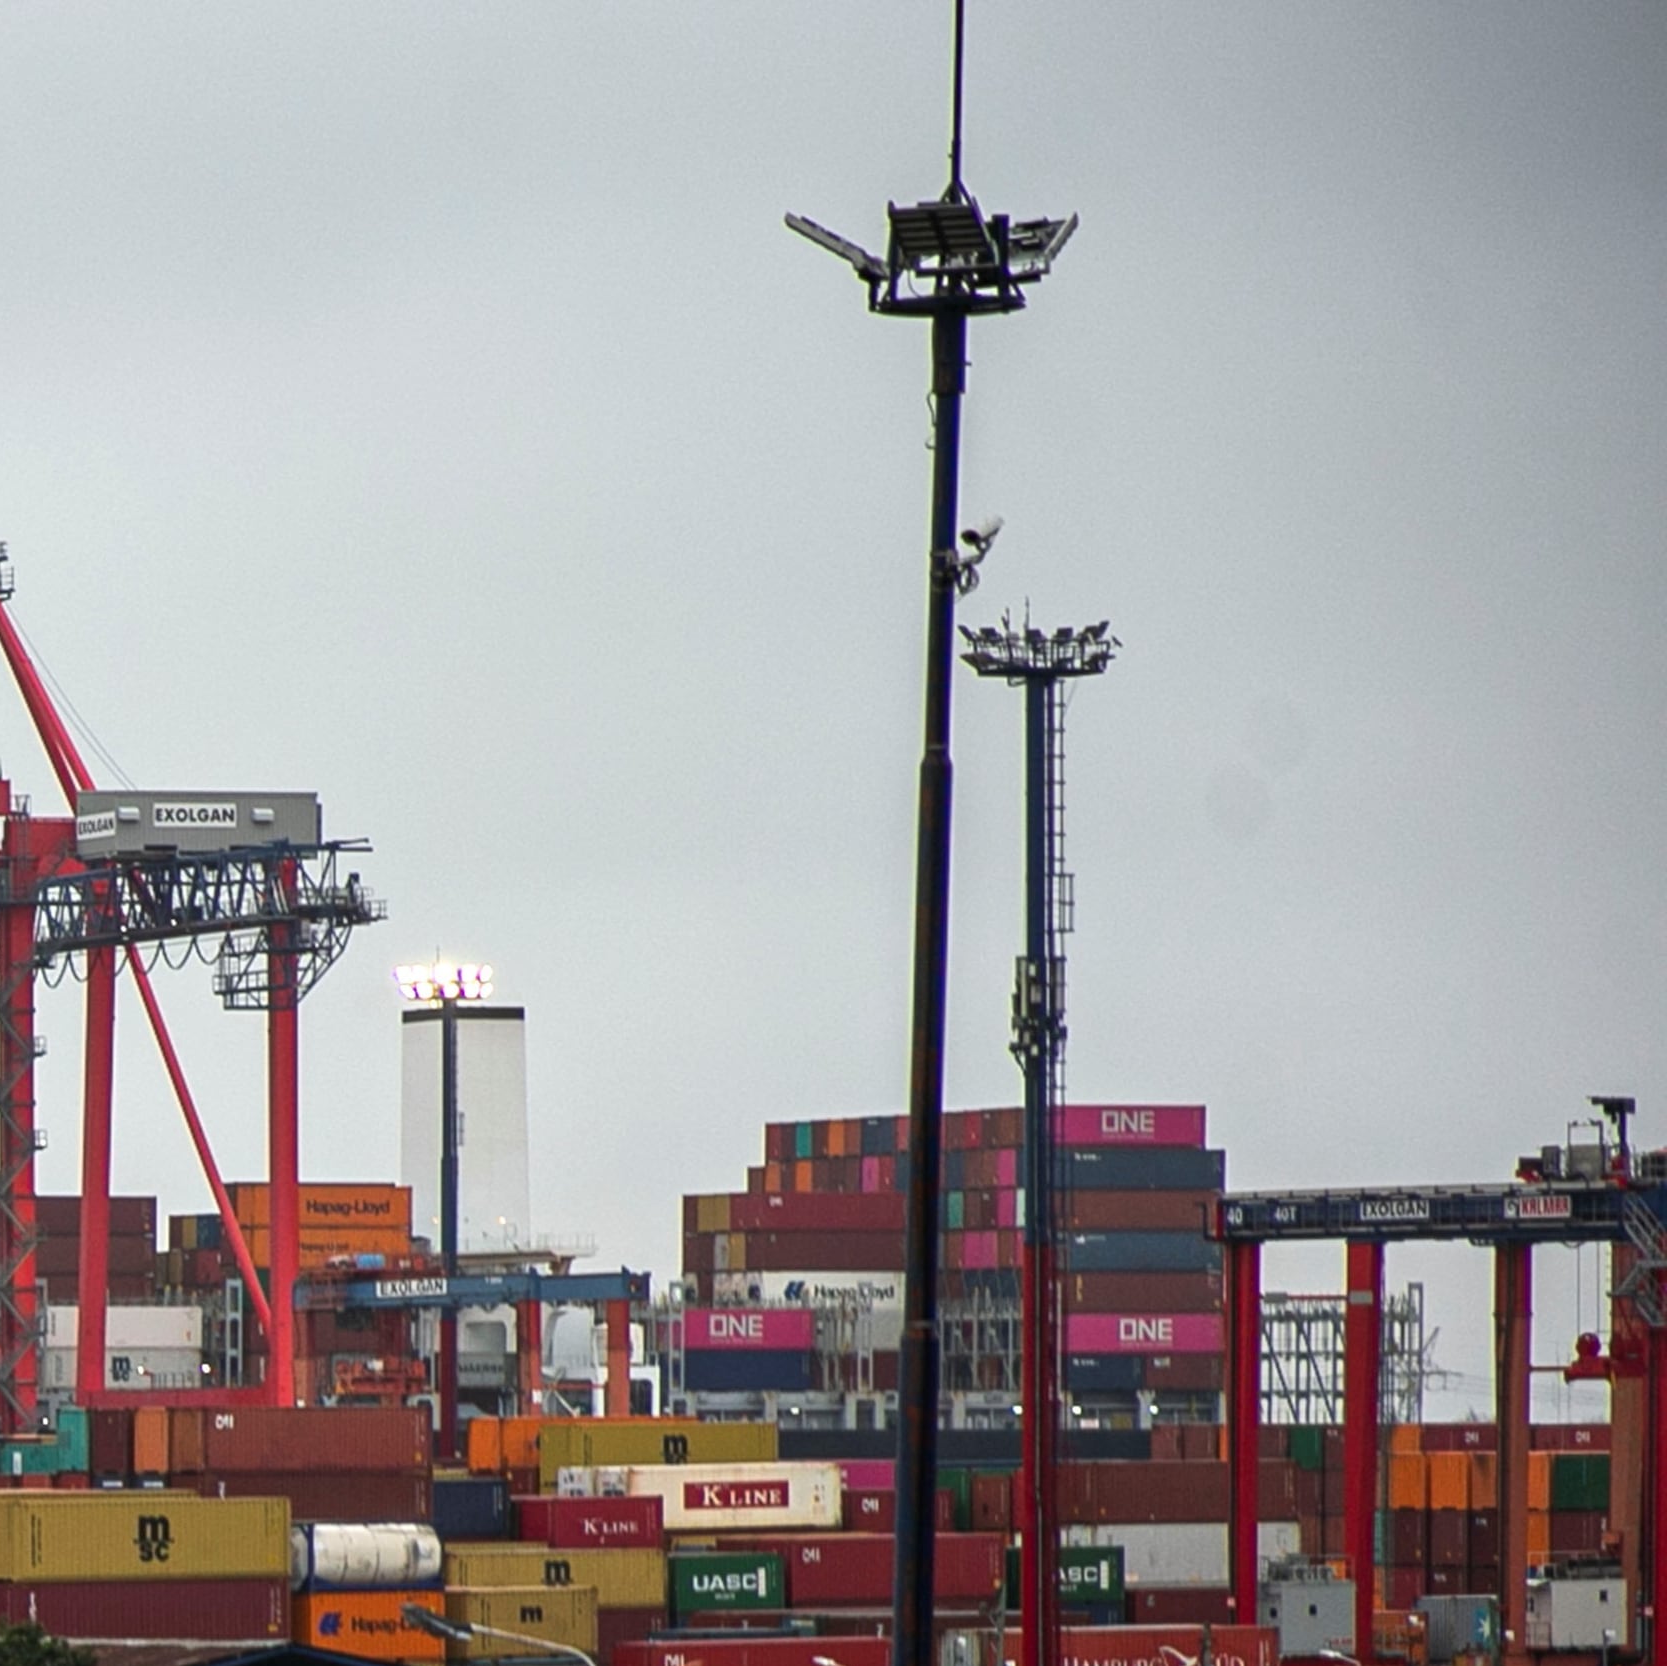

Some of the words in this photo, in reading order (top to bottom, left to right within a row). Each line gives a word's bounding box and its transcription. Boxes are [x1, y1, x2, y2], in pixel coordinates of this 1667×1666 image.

[155, 809, 236, 823] EXOLGAN
[1102, 1111, 1155, 1132] ONE
[306, 1199, 390, 1216] Hapag-Lloyd
[1227, 1206, 1242, 1224] 40
[709, 1315, 763, 1337] ONE
[1120, 1318, 1172, 1340] ONE
[730, 1490, 781, 1505] LINE
[603, 1521, 639, 1534] LINE
[692, 1574, 758, 1592] UASC
